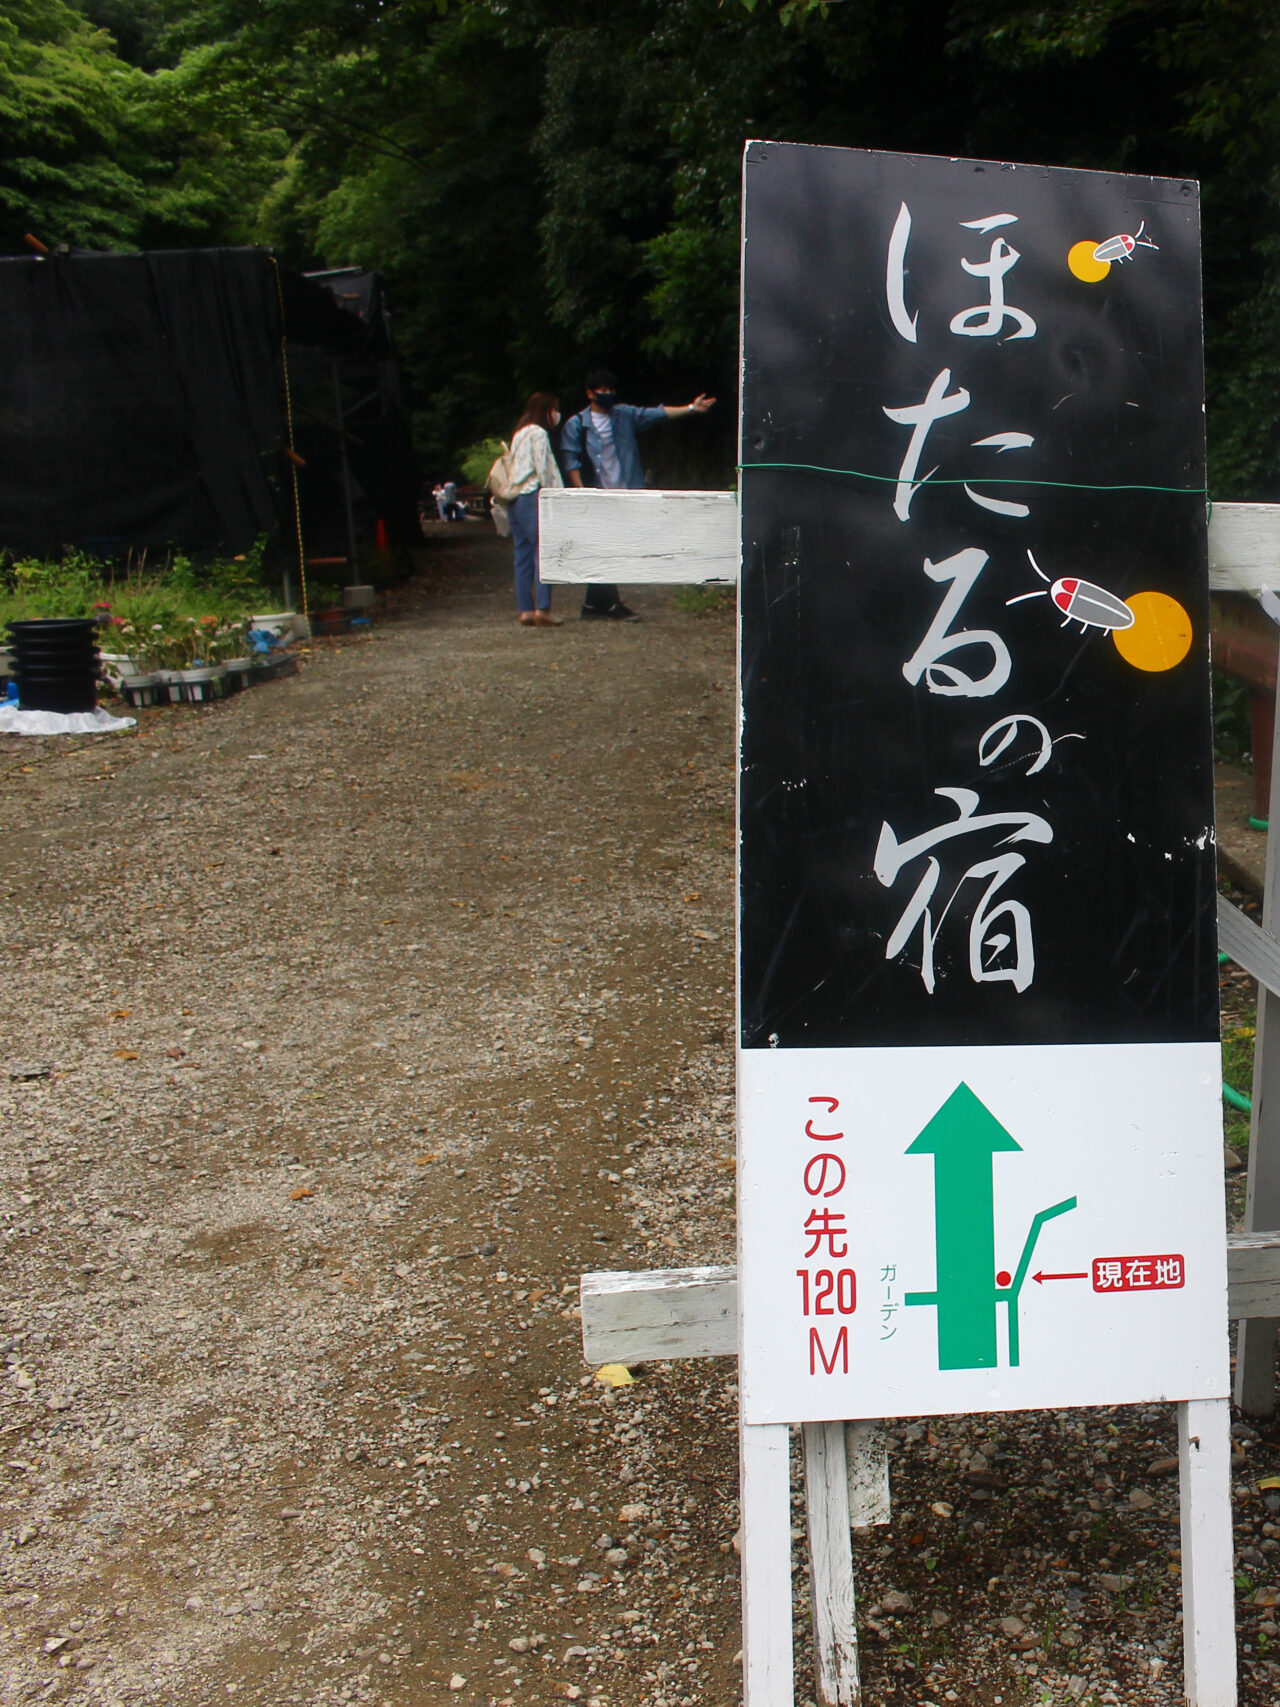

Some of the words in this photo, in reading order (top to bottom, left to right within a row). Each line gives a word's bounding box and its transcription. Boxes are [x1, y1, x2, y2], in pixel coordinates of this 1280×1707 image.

[873, 201, 1054, 994] ほたるの宿
[880, 1263, 898, 1340] ガーデン
[1095, 1260, 1183, 1288] 現在地
